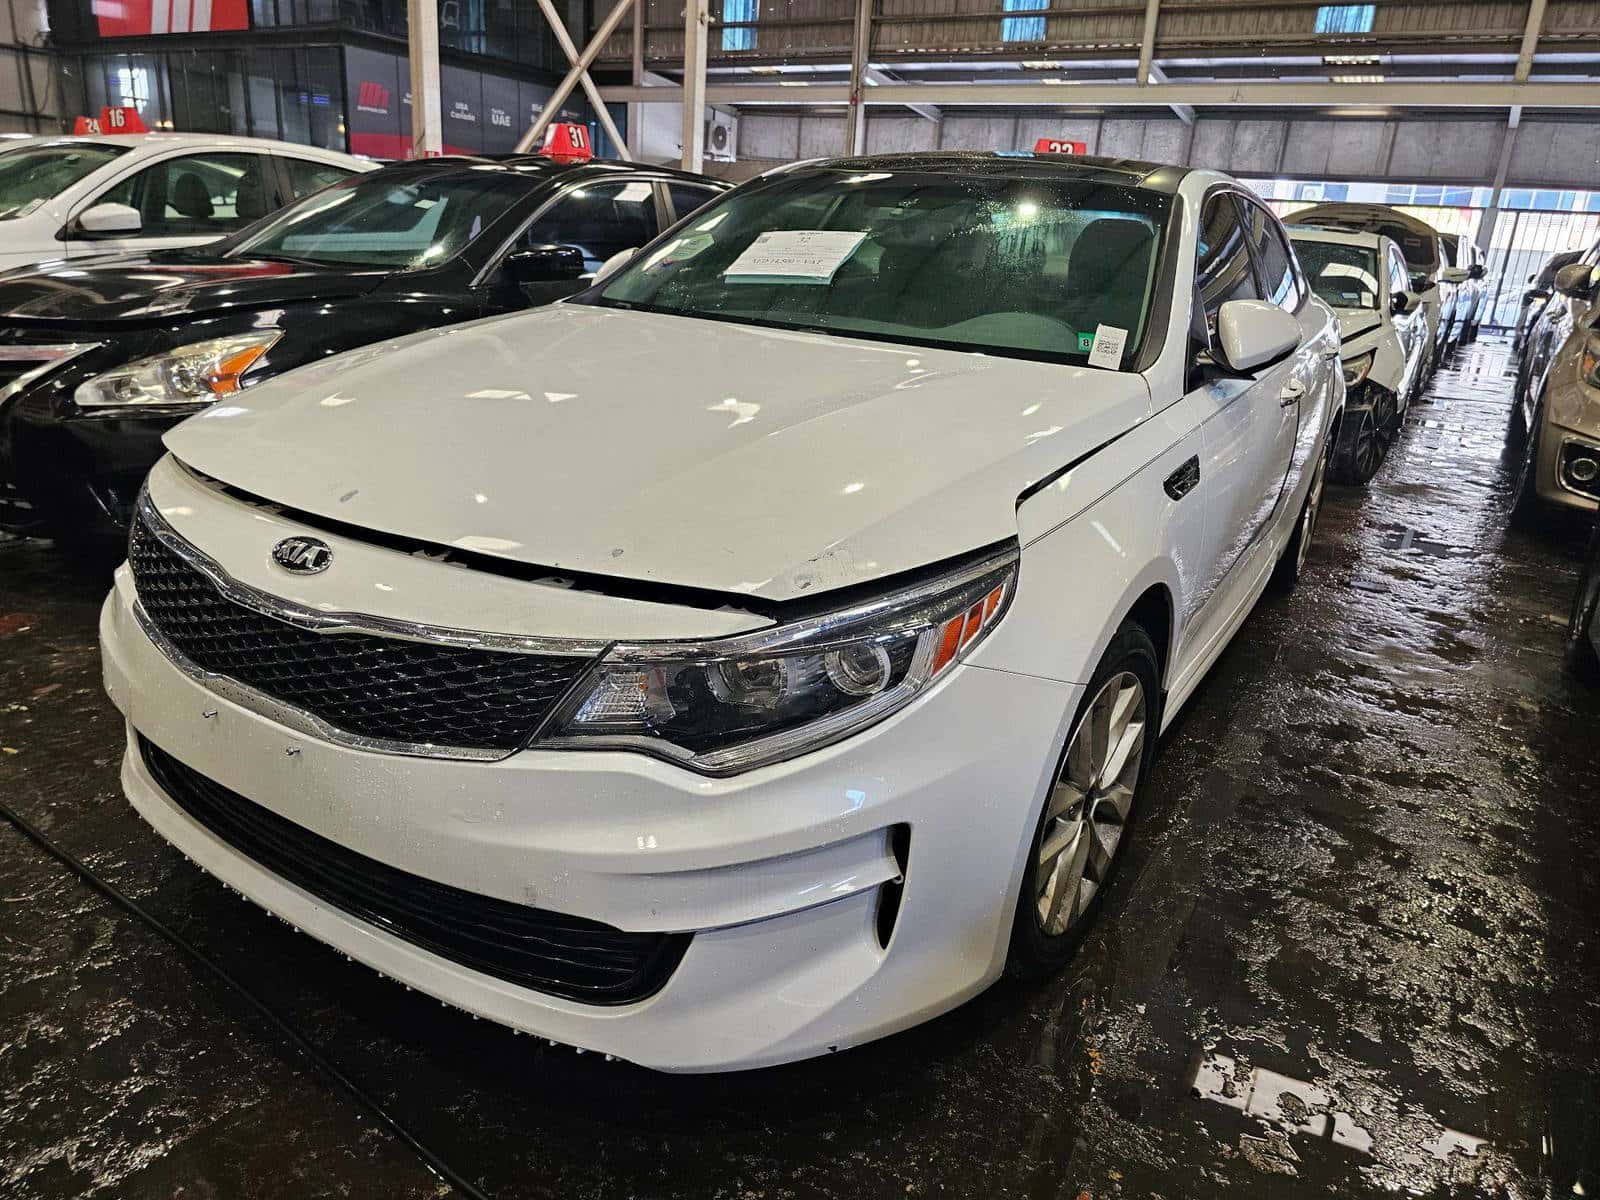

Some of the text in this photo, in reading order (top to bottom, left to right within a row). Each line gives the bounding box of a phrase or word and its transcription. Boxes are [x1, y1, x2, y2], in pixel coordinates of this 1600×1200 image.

[85, 119, 100, 133] 24
[108, 109, 125, 127] 16
[491, 114, 511, 127] UAE
[569, 126, 585, 148] 31
[274, 540, 331, 570] KIA
